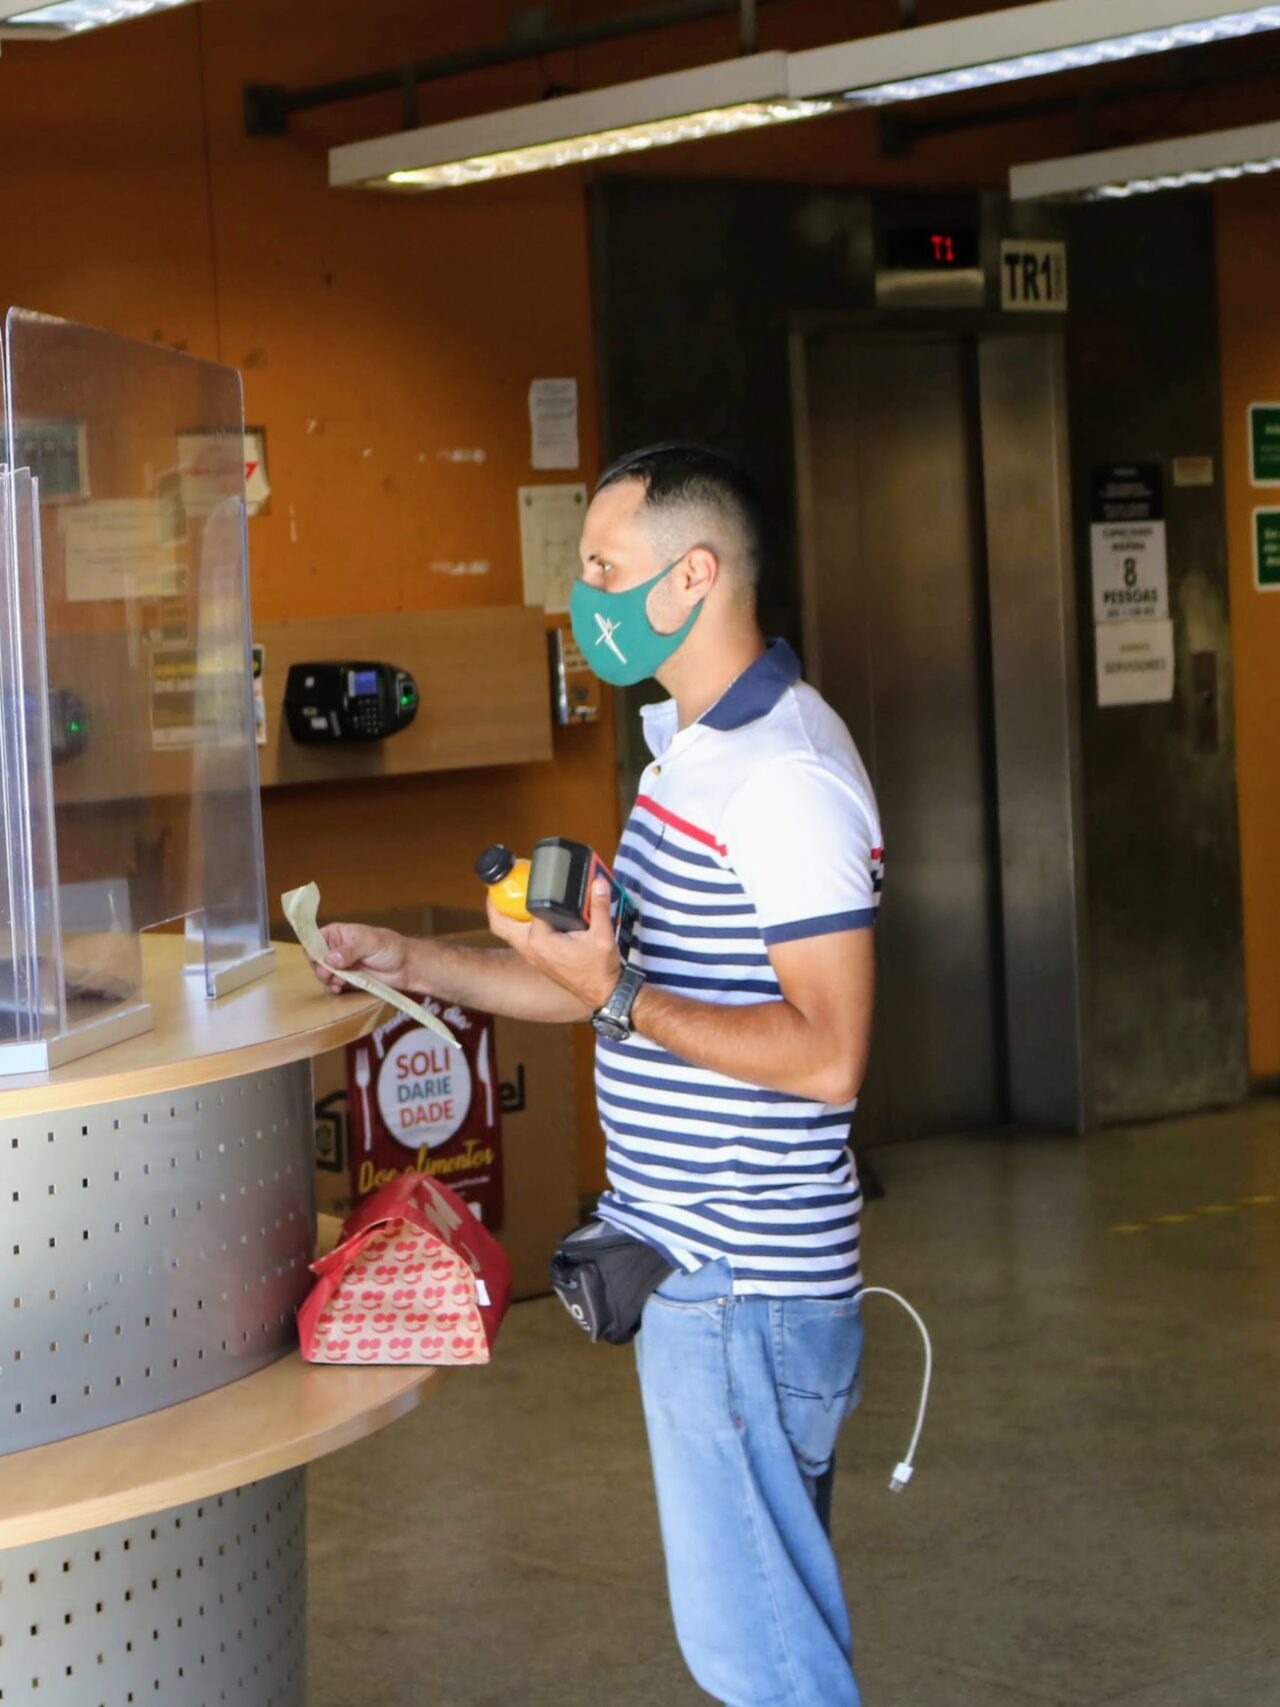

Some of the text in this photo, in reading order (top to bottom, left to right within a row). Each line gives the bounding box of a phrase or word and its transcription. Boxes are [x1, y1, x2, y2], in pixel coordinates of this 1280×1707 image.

[930, 234, 955, 262] T1
[1004, 253, 1054, 302] TR1
[1123, 556, 1138, 587] 8
[1103, 588, 1158, 604] PESSOAS
[395, 1046, 450, 1079] SOLI
[397, 1076, 452, 1103] DARIE
[399, 1099, 455, 1129] DADE
